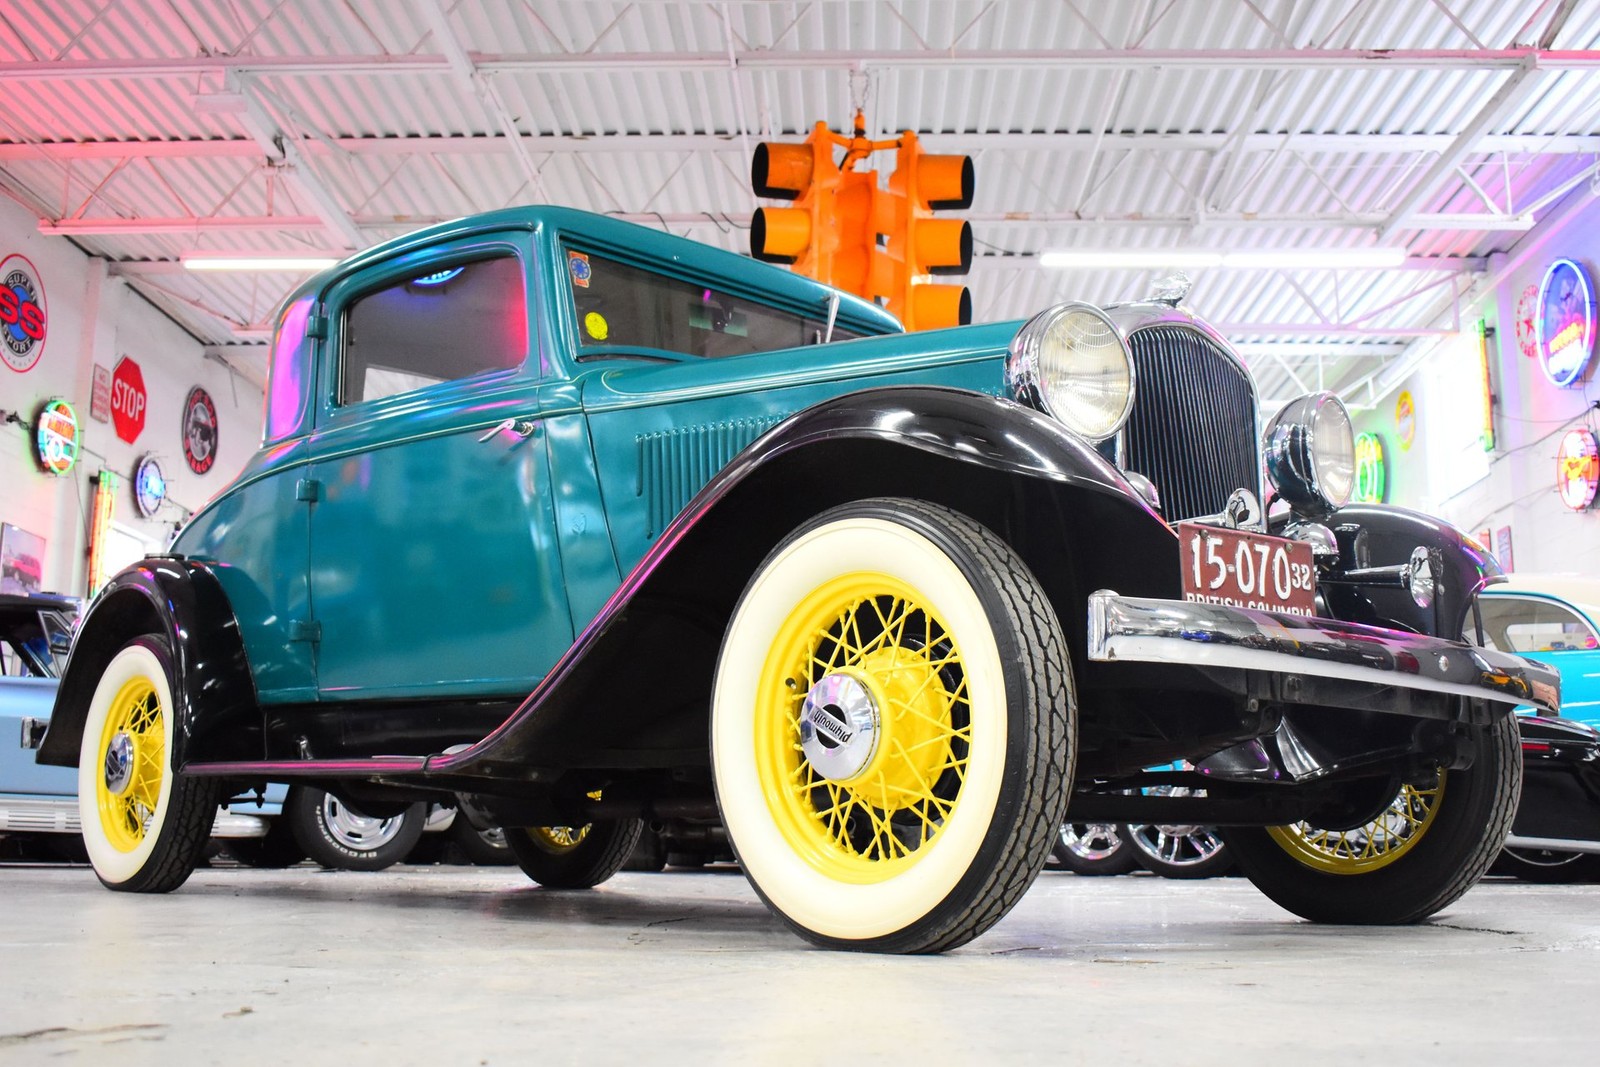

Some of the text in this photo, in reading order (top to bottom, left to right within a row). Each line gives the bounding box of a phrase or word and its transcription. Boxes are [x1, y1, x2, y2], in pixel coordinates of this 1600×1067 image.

[0, 283, 45, 341] SS
[112, 378, 145, 422] STOP
[1191, 534, 1312, 600] 15-070 32
